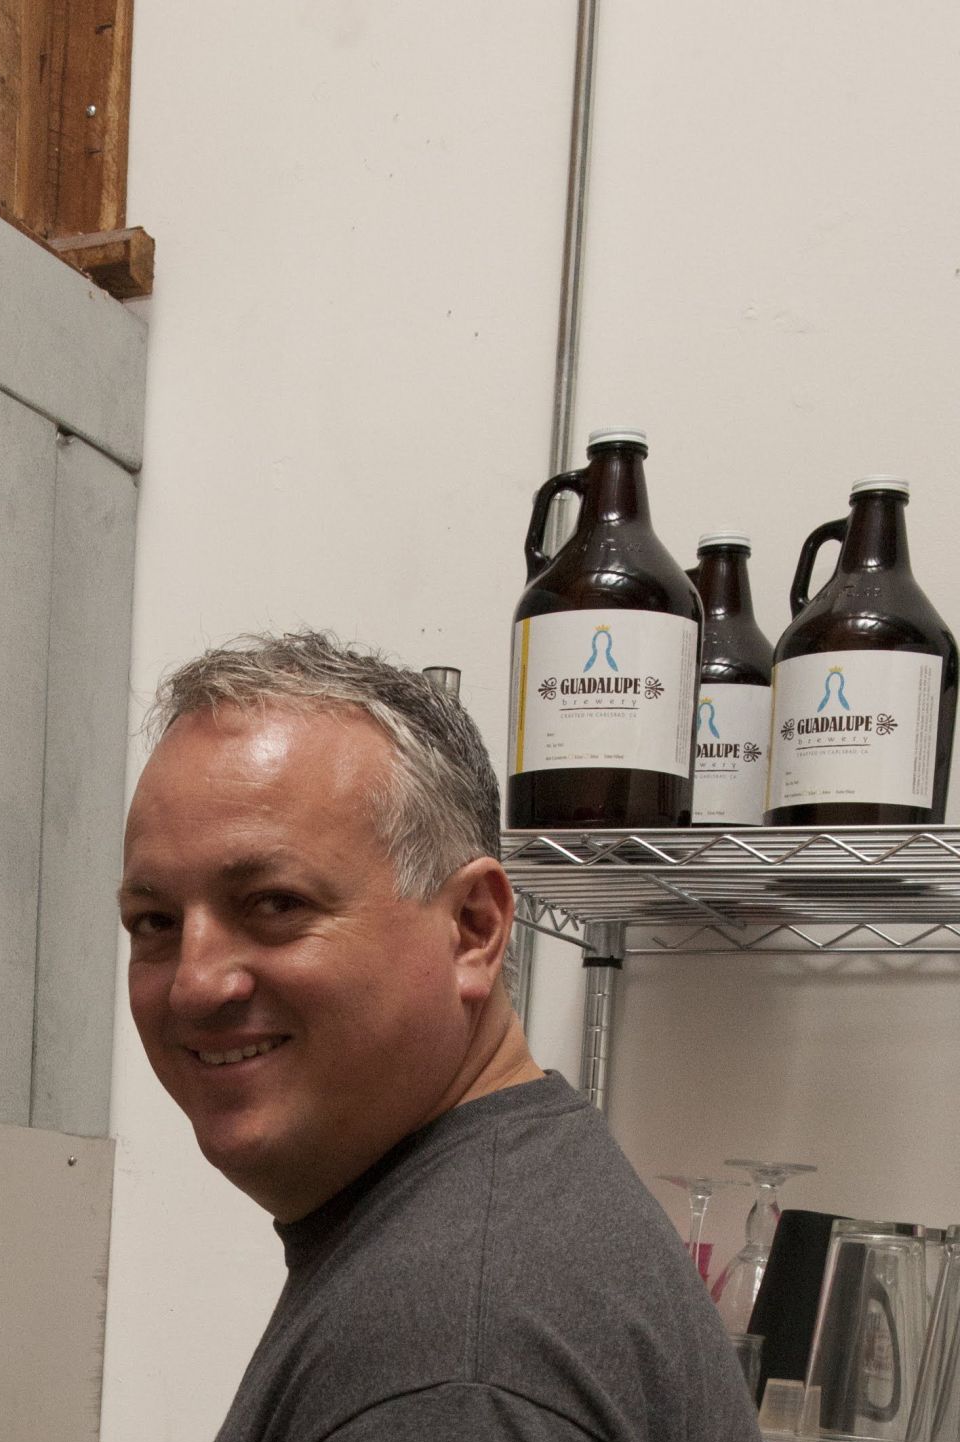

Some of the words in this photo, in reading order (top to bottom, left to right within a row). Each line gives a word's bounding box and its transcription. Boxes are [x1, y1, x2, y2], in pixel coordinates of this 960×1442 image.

[560, 677, 641, 695] GUADALUPE
[562, 698, 637, 707] brewery
[797, 715, 872, 736] GUADALUPE
[798, 737, 869, 746] brewery
